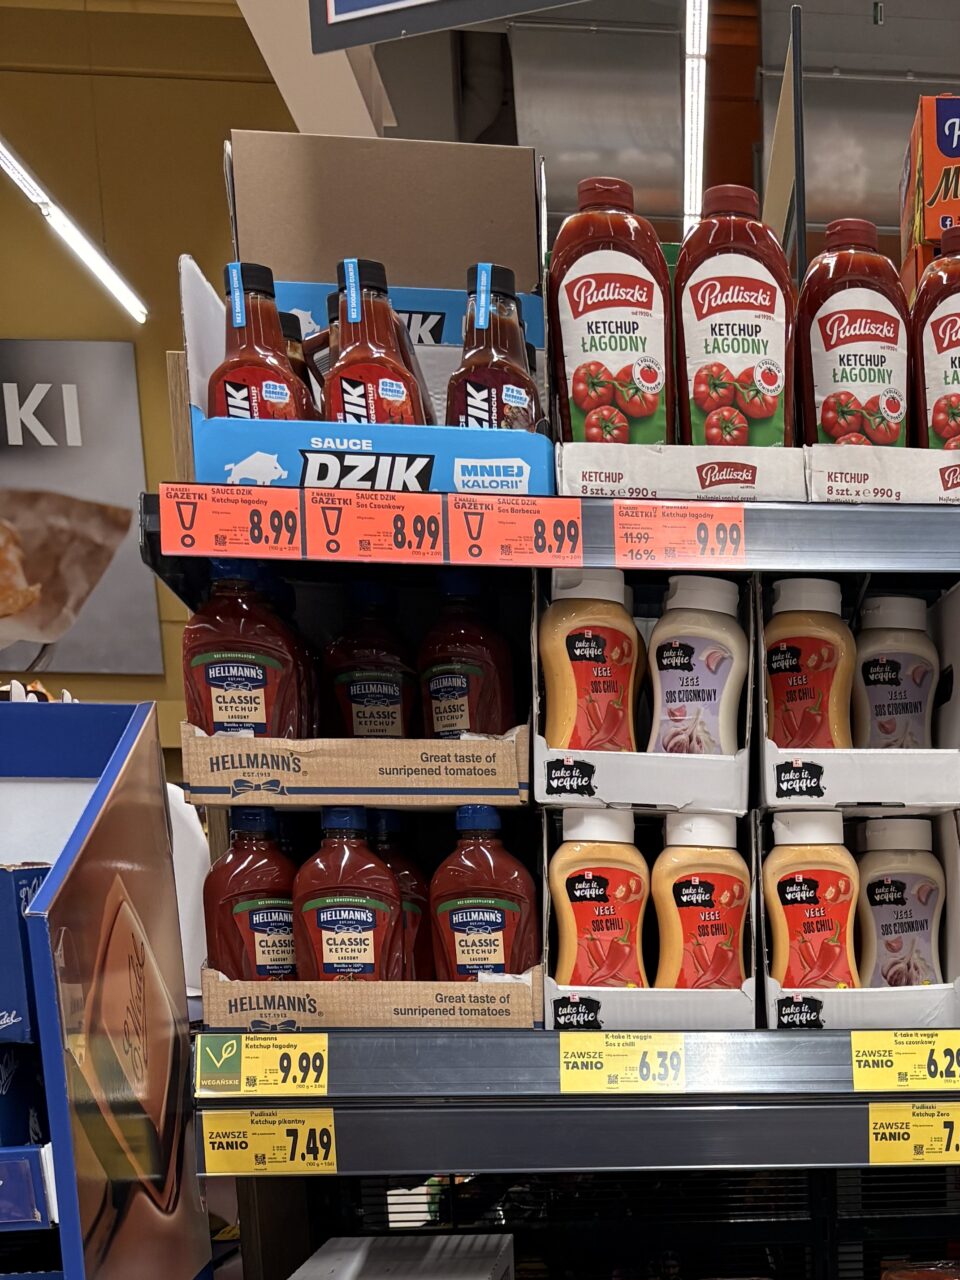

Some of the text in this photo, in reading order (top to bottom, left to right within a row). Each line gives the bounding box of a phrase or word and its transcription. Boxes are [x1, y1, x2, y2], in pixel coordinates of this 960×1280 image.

[573, 278, 648, 311] Pudliszki
[587, 321, 639, 336] KETCHUP
[581, 336, 647, 353] ŁAGODNY
[838, 353, 886, 368] KETCHUP
[832, 368, 892, 384] ŁAGODNY
[3, 383, 82, 446] KI
[310, 437, 372, 450] SAUCE
[304, 453, 430, 492] DZIK
[460, 464, 524, 478] MNIEJ
[581, 471, 623, 483] KETCHUP
[702, 464, 753, 486] Pudliszki
[166, 492, 208, 500] GAZETKI
[211, 488, 252, 496] SAUCE DZIK
[581, 486, 588, 495] 8
[590, 487, 606, 495] szt.
[628, 487, 648, 497] 990
[651, 490, 657, 498] g
[212, 496, 268, 506] Ketchup łagodny
[497, 498, 519, 506] SAUCE
[661, 510, 687, 520] Ketchup
[250, 508, 297, 545] 8.99
[393, 514, 440, 550] 8.99
[533, 518, 579, 554] 8.99
[623, 532, 650, 544] 11.99
[696, 522, 741, 556] 9.99
[622, 549, 656, 562] -16%
[208, 665, 263, 680] HELLMANN'S
[679, 676, 699, 686] VEGE
[215, 694, 260, 706] CLASSIC
[666, 688, 716, 703] SOS CZOSNKOWY
[209, 752, 301, 773] HELLMANN'S
[420, 752, 496, 764] Great taste of
[378, 765, 497, 778] sunripened tomatoes
[320, 909, 373, 923] HELLMANN'S
[594, 906, 615, 916] VEGE
[592, 918, 624, 932] SOS CHILI
[326, 936, 369, 947] CLASSIC
[558, 1005, 576, 1015] take
[564, 1051, 603, 1059] ZAWSZE
[279, 1052, 324, 1083] 9.99
[564, 1061, 603, 1070] TANIO
[639, 1051, 681, 1082] 6.39
[856, 1060, 894, 1068] TANIO
[209, 1131, 248, 1139] ZAWSZE
[210, 1141, 248, 1150] TANIO
[286, 1128, 331, 1161] 7.49
